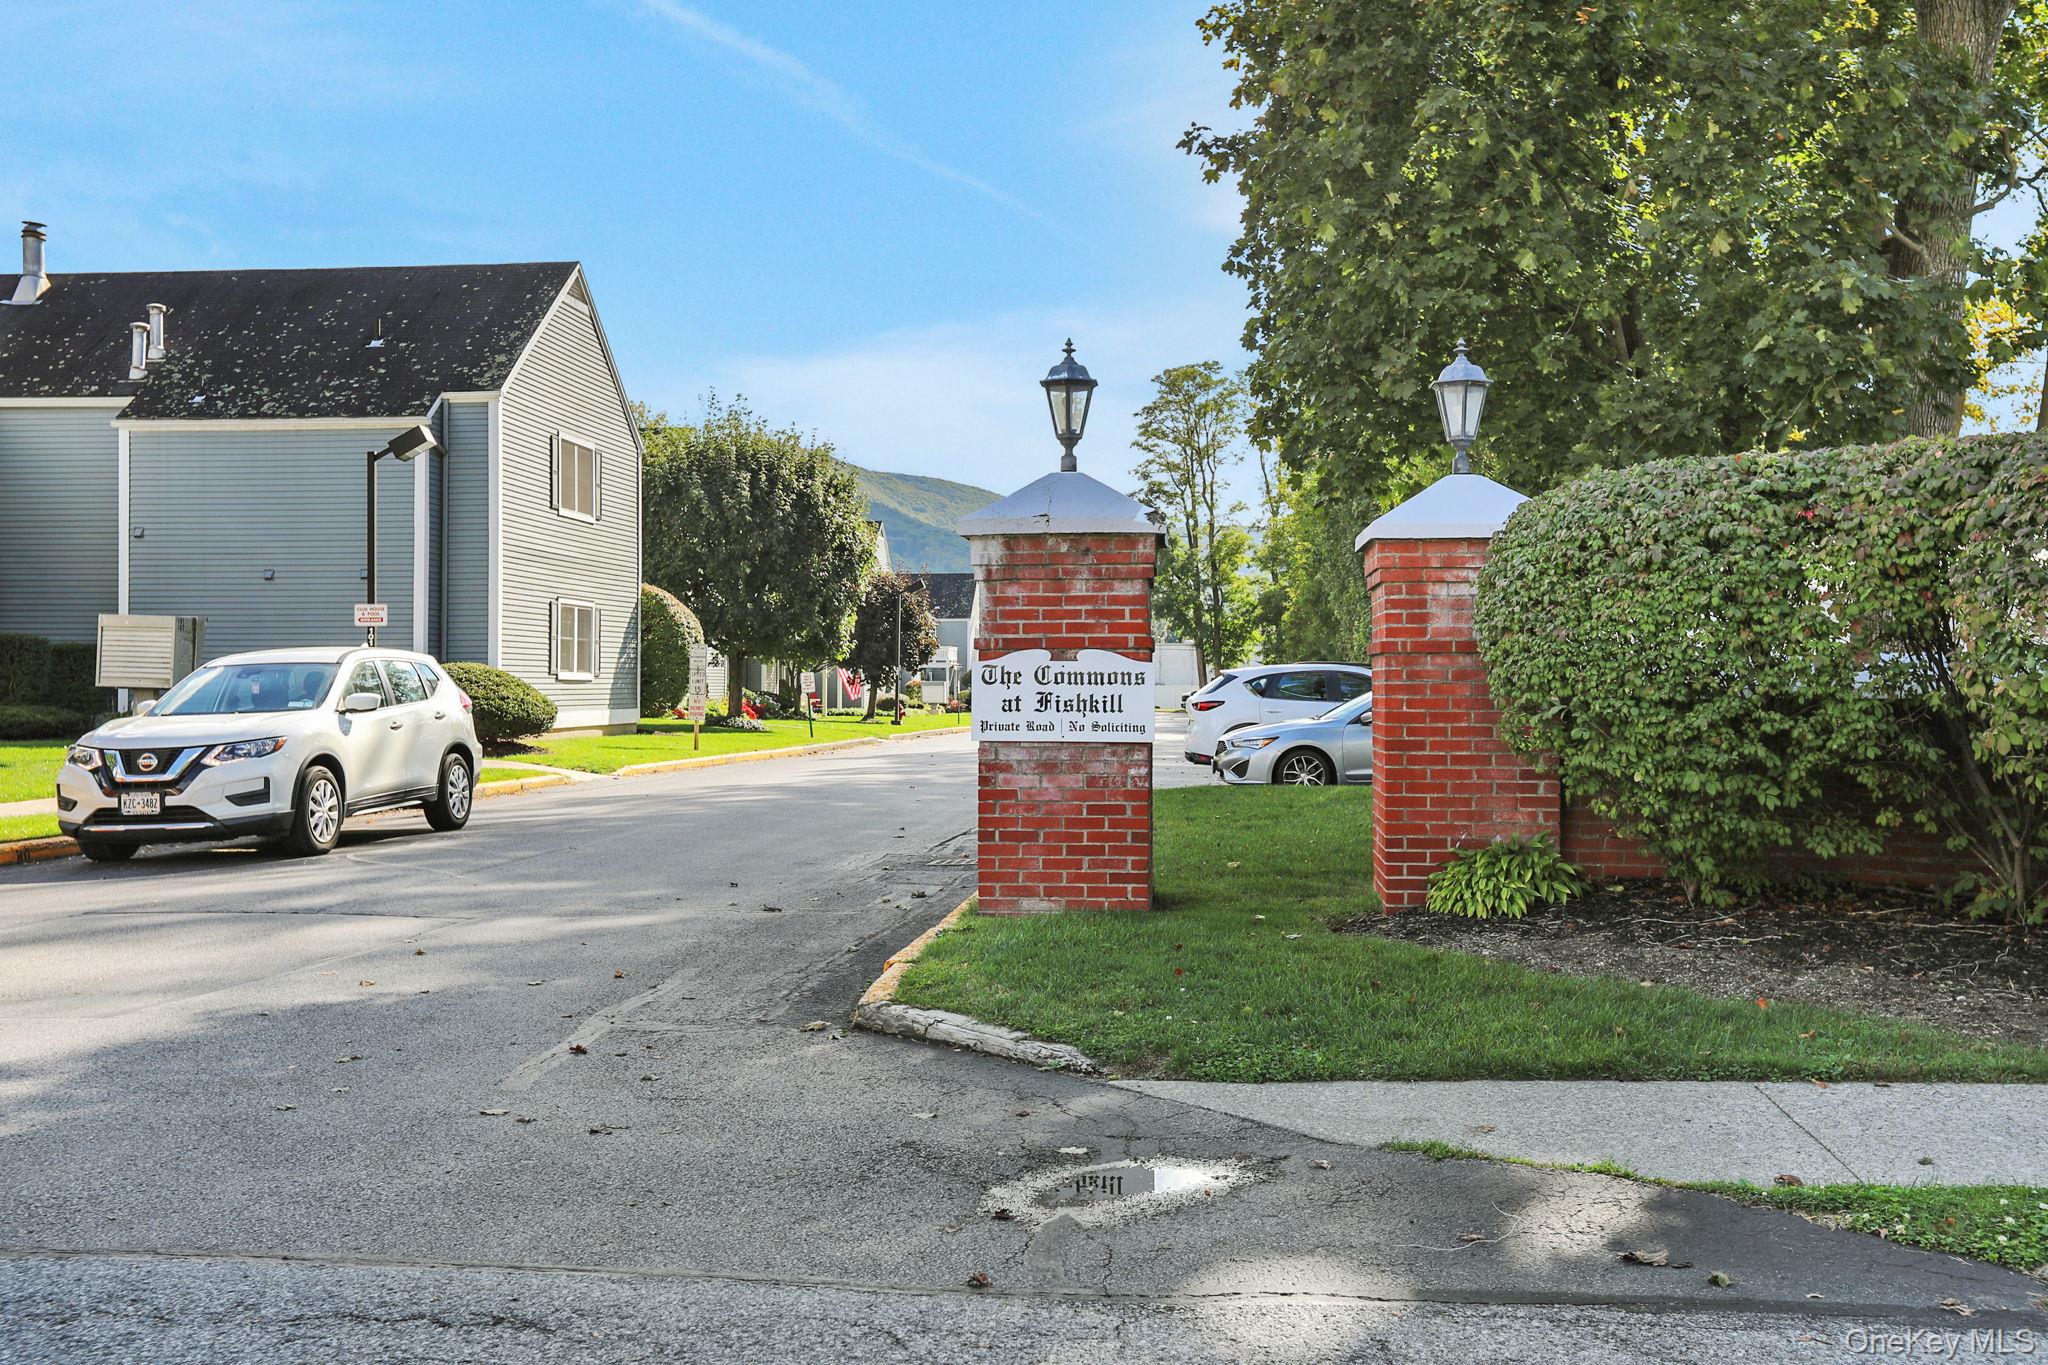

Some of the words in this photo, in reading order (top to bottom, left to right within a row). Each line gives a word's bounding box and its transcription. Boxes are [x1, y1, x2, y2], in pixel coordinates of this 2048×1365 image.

[981, 664, 1023, 689] The
[1034, 664, 1146, 686] Commons
[1001, 694, 1022, 714] at
[1033, 691, 1124, 718] Fishkill
[980, 720, 1020, 734] Private
[1026, 720, 1055, 733] Road
[1068, 720, 1085, 733] No
[1091, 720, 1146, 735] Soliciting
